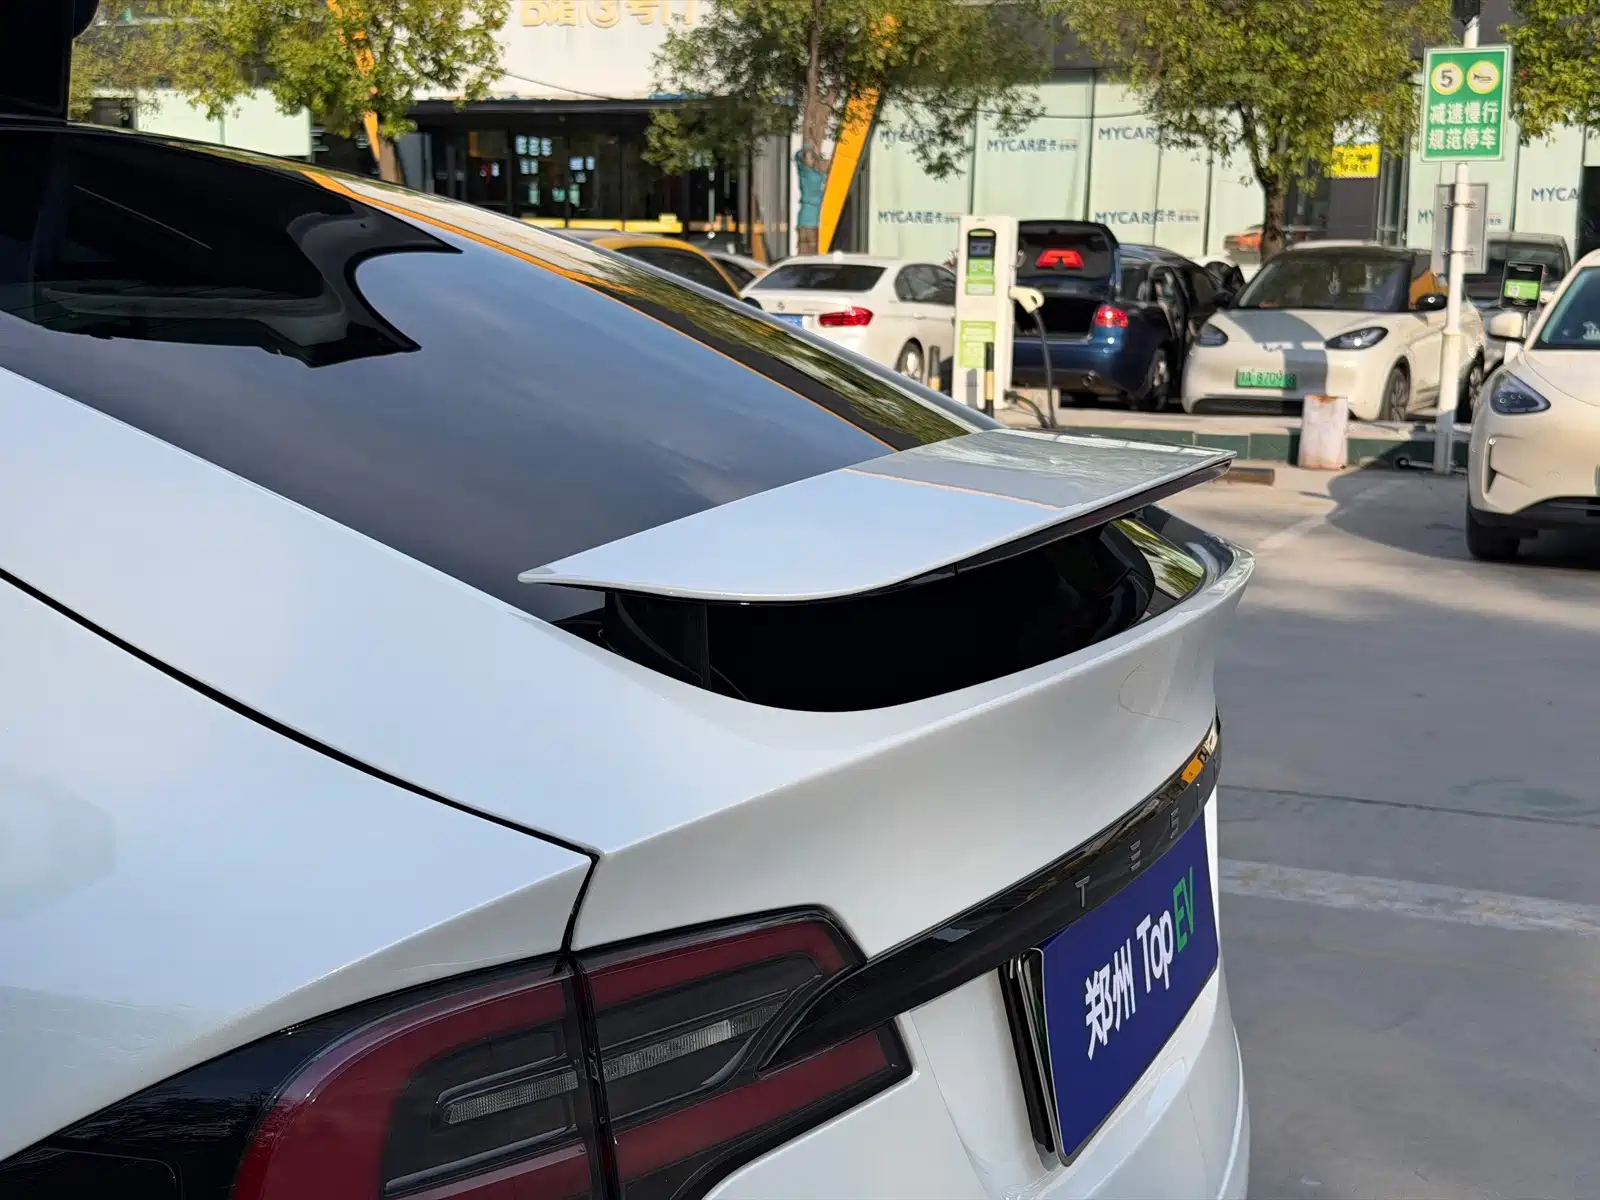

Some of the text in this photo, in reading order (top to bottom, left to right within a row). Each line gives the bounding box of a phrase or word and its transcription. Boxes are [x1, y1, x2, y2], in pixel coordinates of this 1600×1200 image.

[1440, 69, 1453, 88] 5
[1430, 101, 1499, 125] 减速慢行
[1428, 128, 1496, 150] 规范停车
[1531, 187, 1579, 201] MYCA
[1084, 938, 1136, 1061] 郑州
